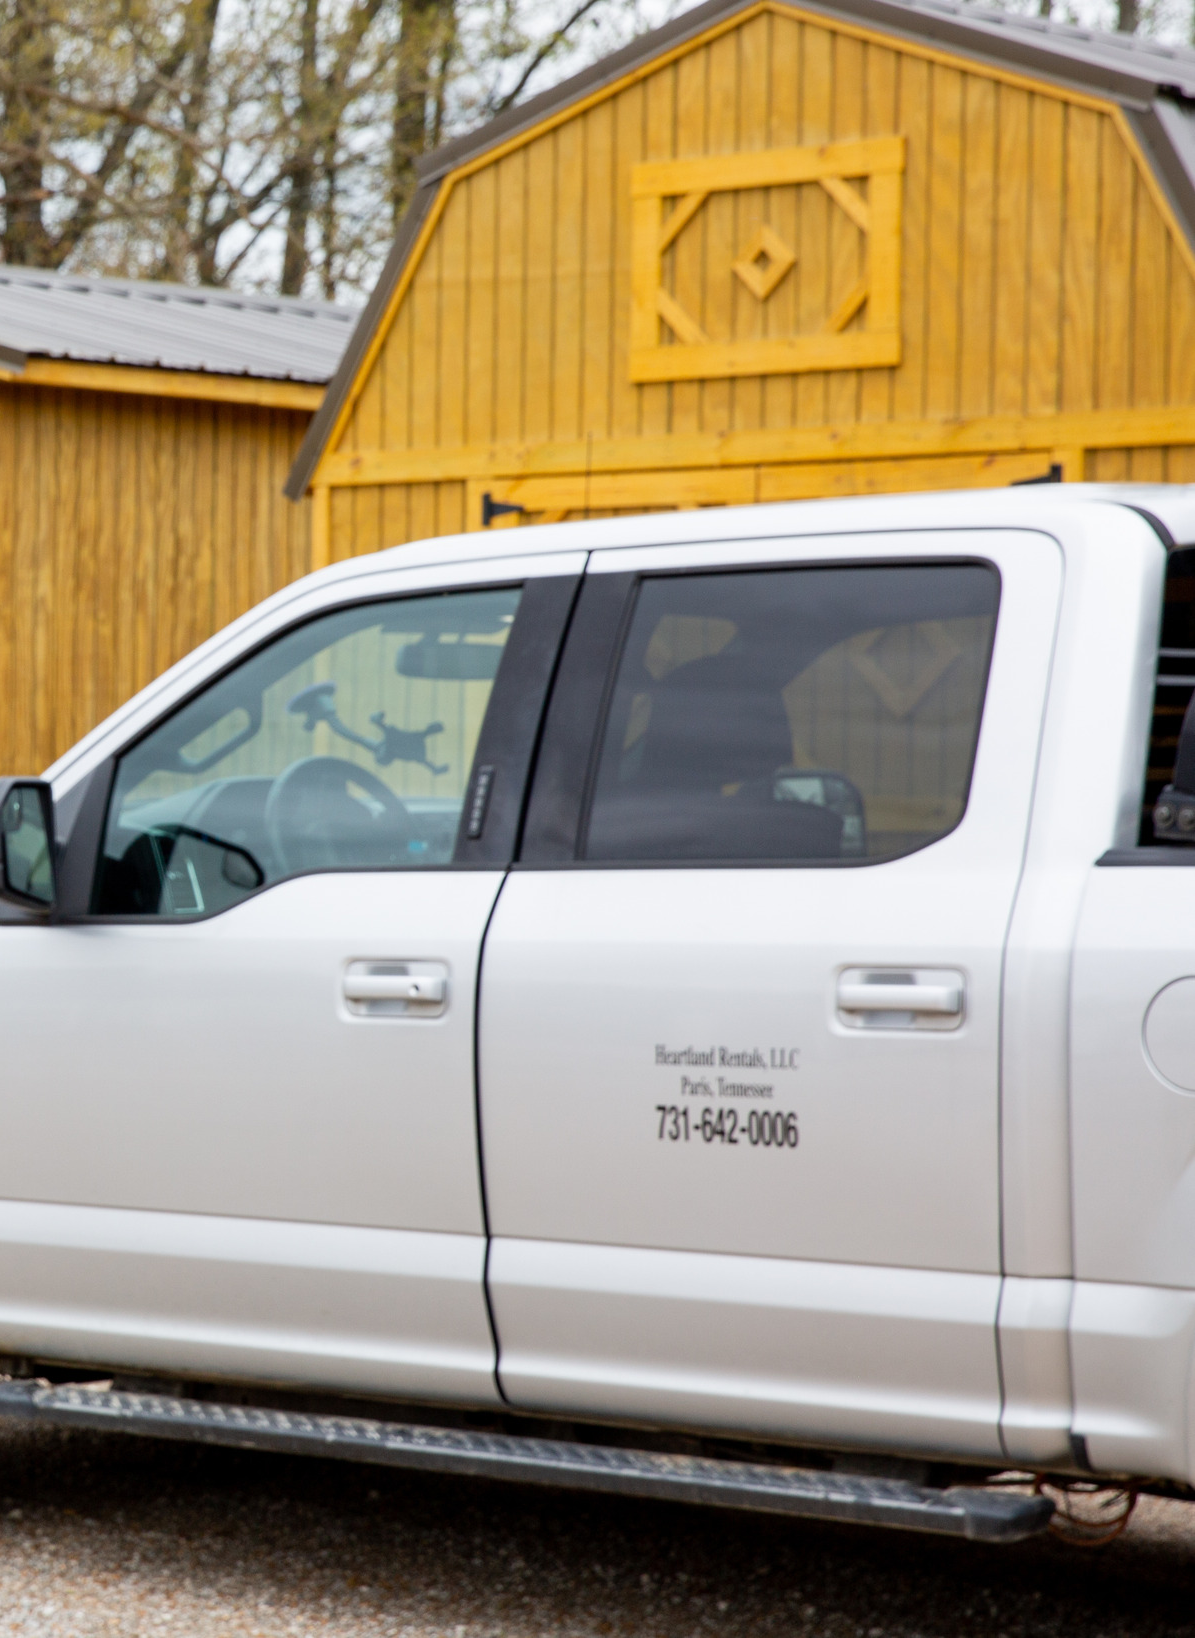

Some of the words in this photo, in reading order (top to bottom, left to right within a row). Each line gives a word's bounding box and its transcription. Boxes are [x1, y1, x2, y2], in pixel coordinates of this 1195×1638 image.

[655, 1044, 714, 1067] Heartland
[719, 1045, 767, 1070] Rentals,
[770, 1048, 800, 1070] LLC
[681, 1075, 714, 1098] Paris,
[717, 1076, 774, 1098] Tennessee
[656, 1104, 799, 1148] 731-642-0006
